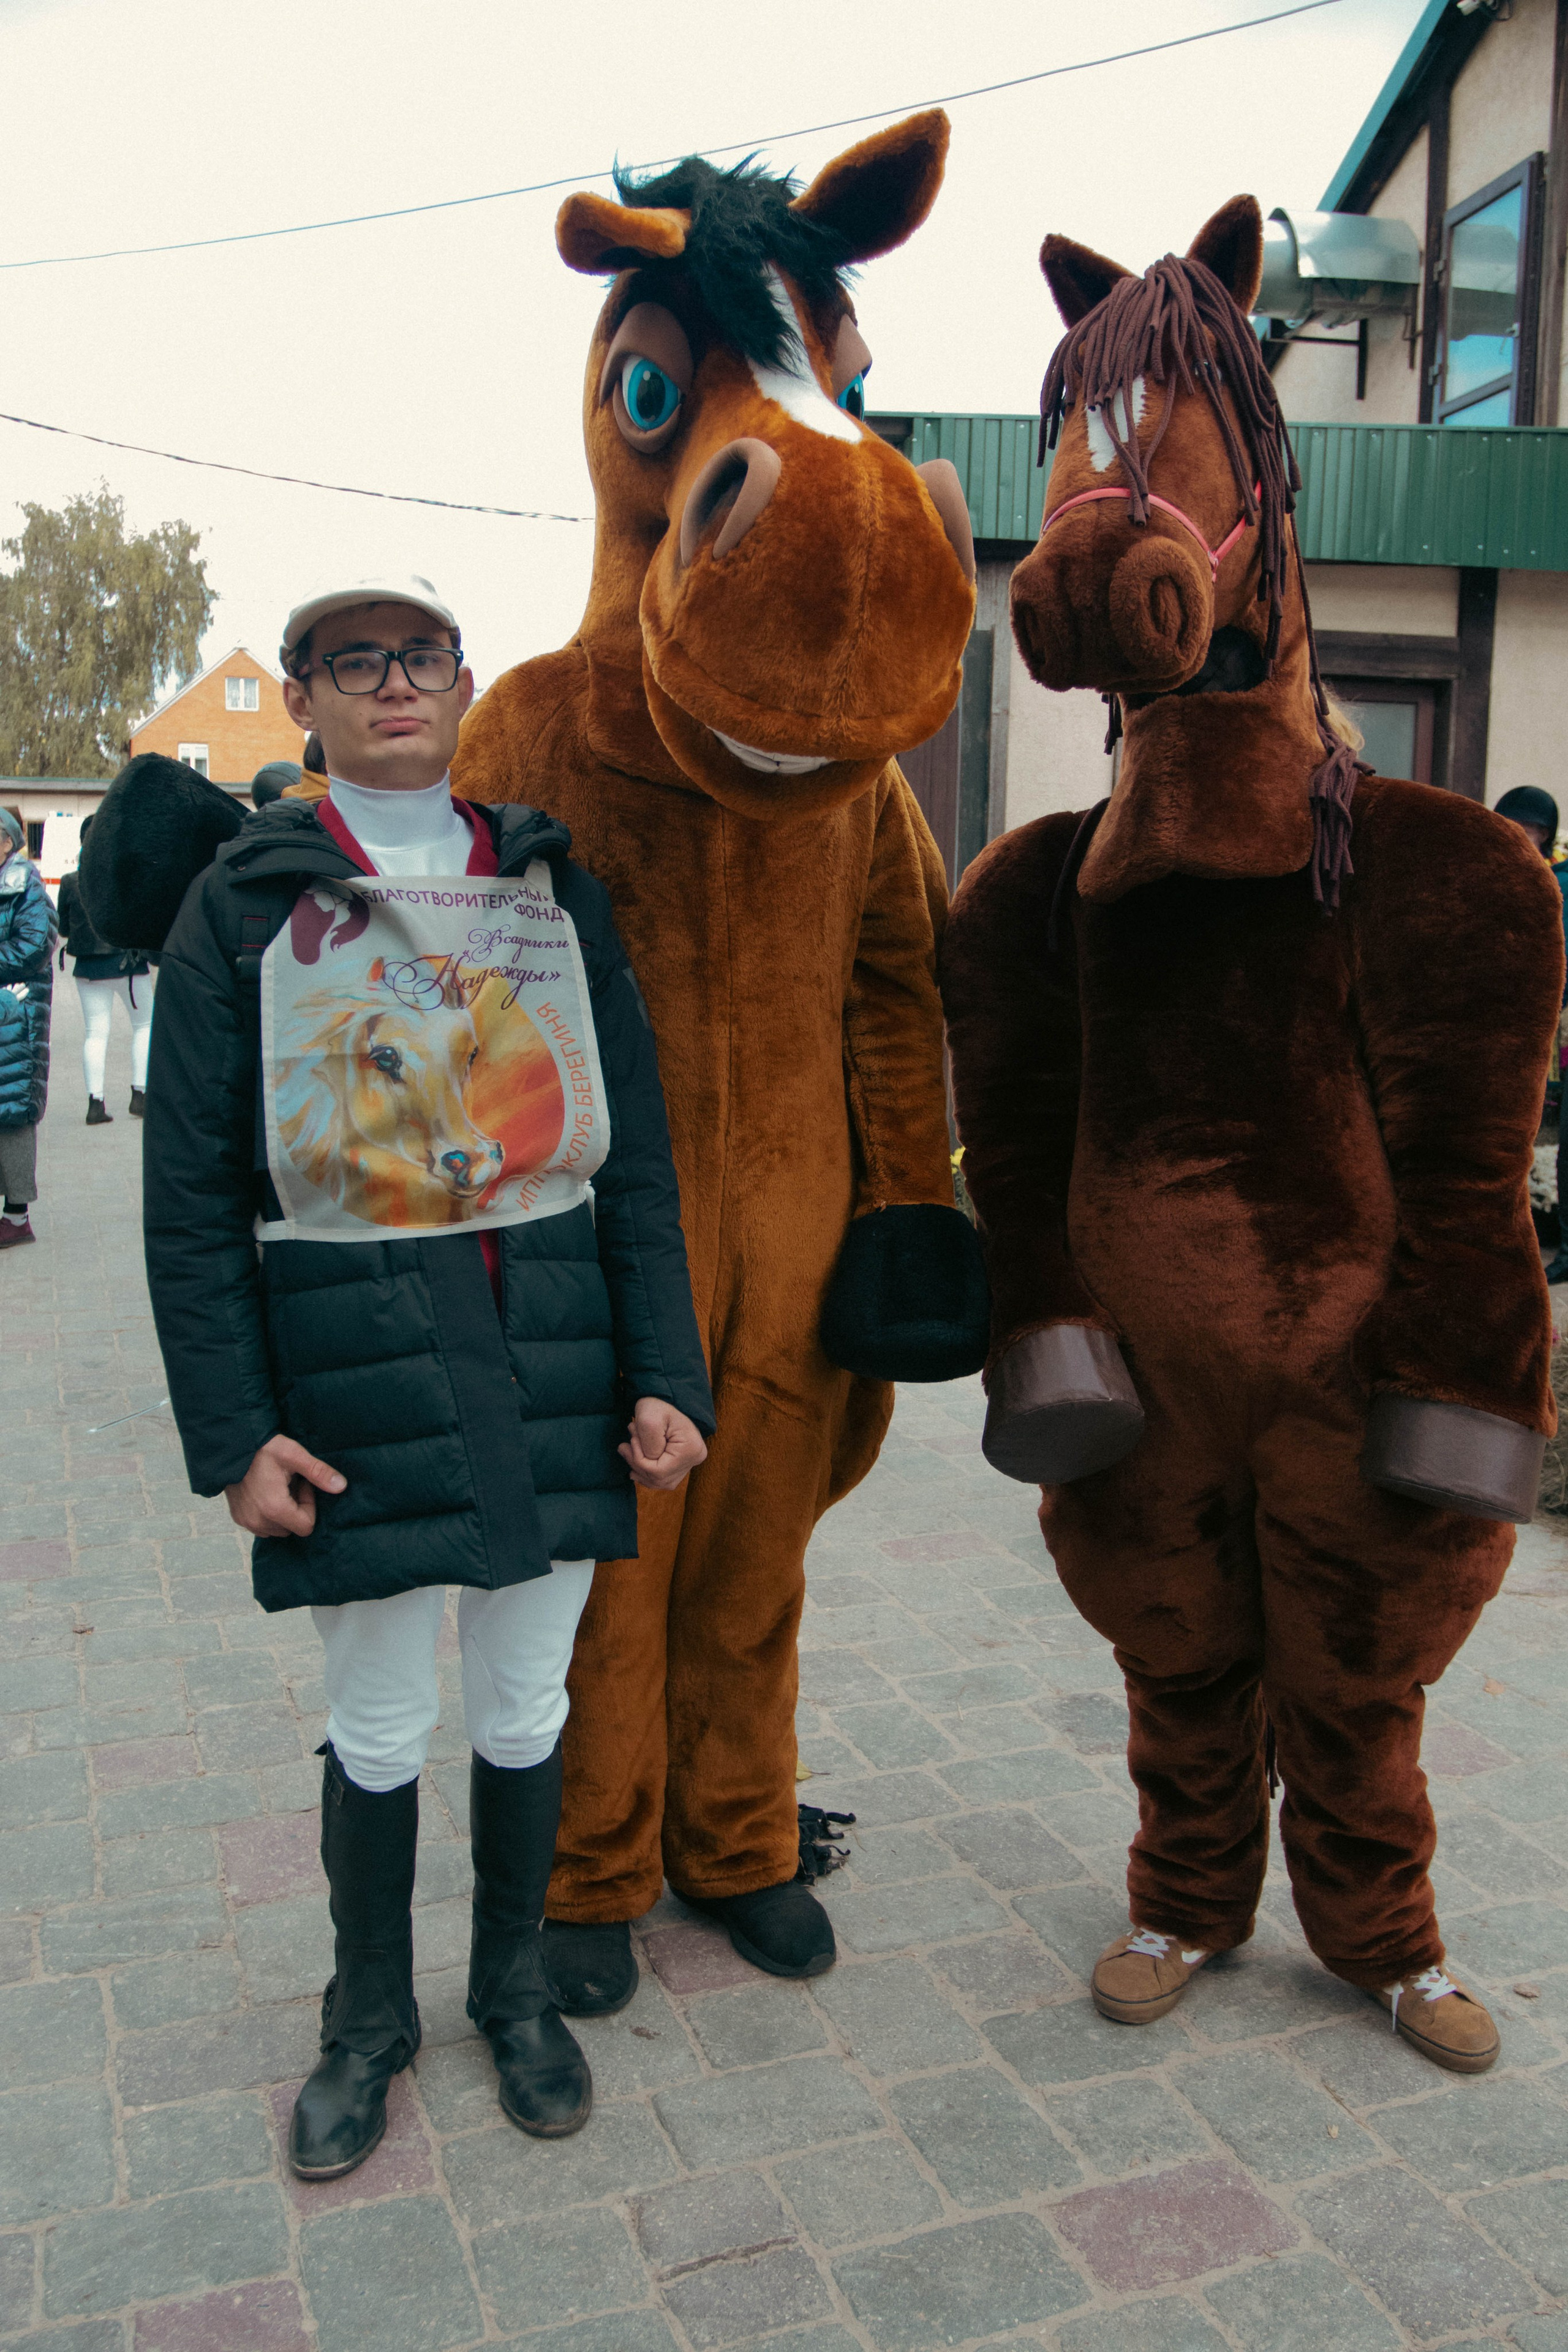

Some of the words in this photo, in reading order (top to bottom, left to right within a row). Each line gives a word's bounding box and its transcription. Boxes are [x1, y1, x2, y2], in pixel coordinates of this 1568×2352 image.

[360, 886, 549, 909] БЛАГОТВОРИТЕЛЬНЫ
[514, 903, 565, 922] ФОНД
[536, 1001, 593, 1107] БЕРЕГИНЯ
